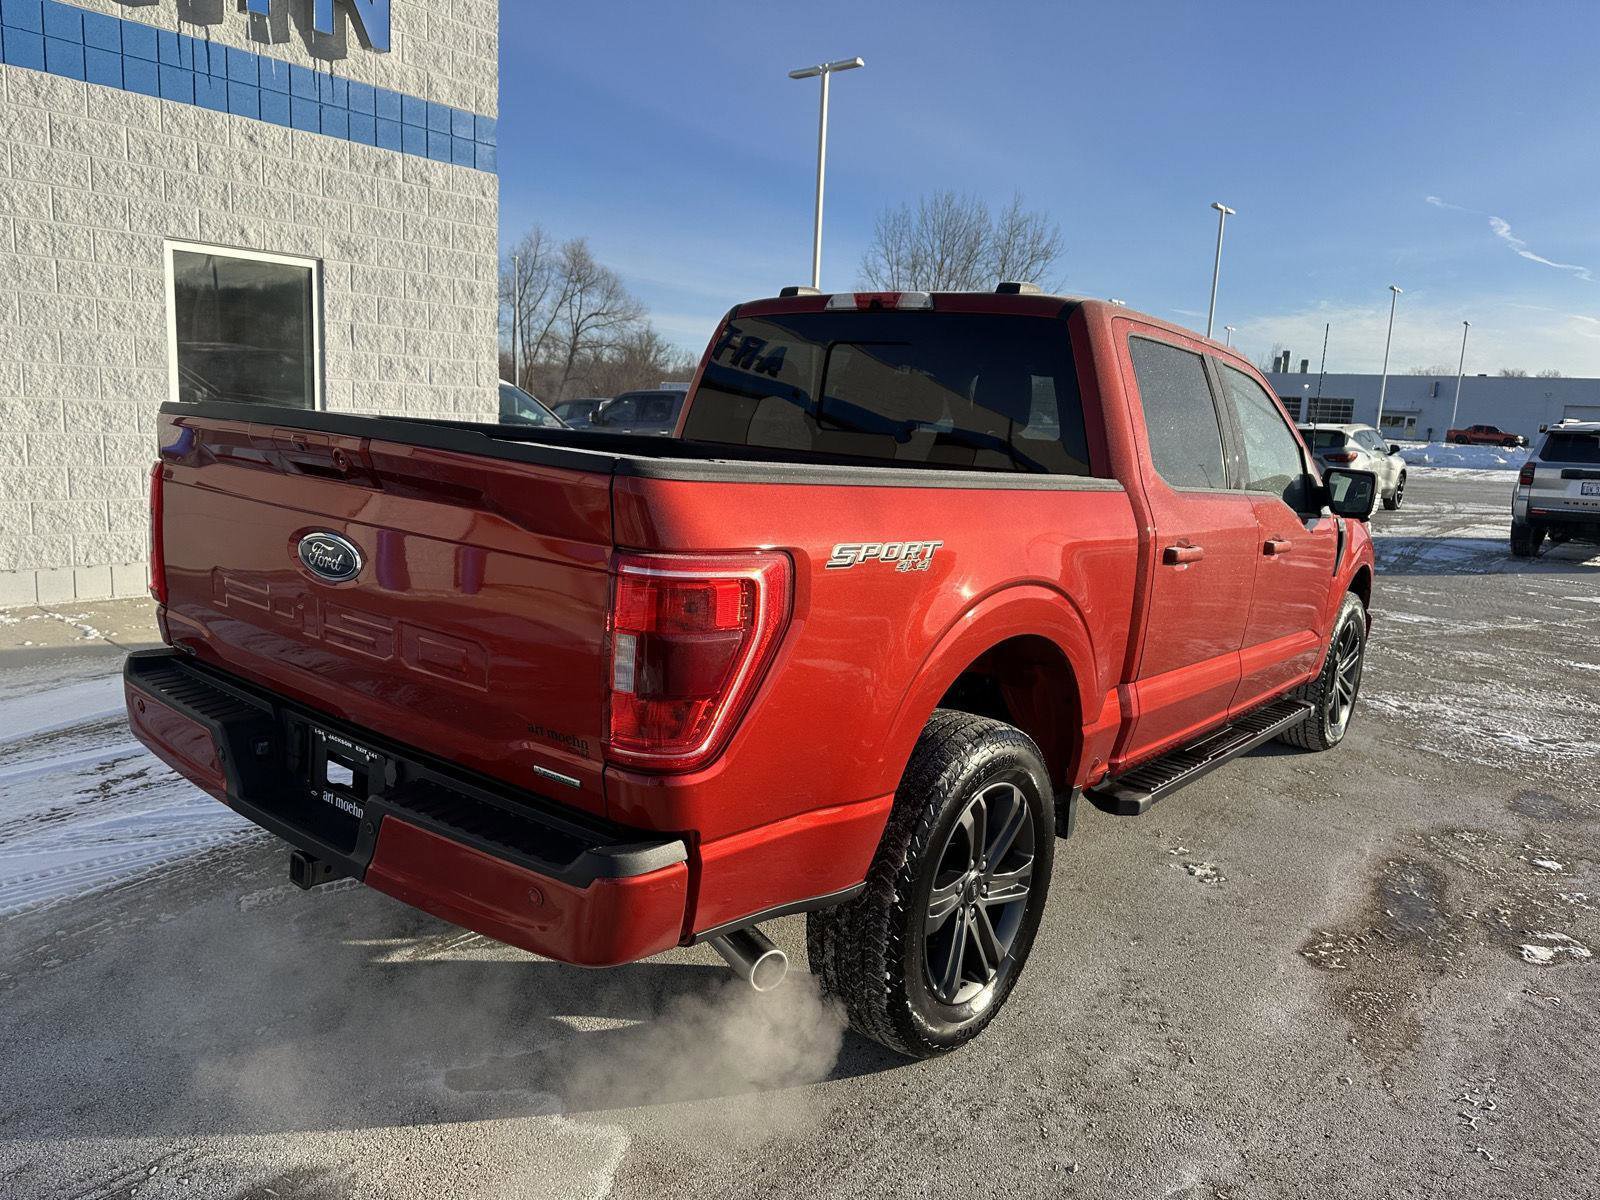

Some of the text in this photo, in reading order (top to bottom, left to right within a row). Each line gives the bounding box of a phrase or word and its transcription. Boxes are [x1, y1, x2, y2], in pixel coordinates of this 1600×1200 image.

[308, 541, 343, 571] Ford
[825, 540, 944, 570] SPORT
[211, 565, 489, 692] F-150
[328, 734, 353, 748] JACKSON
[322, 790, 364, 819] art moehn
